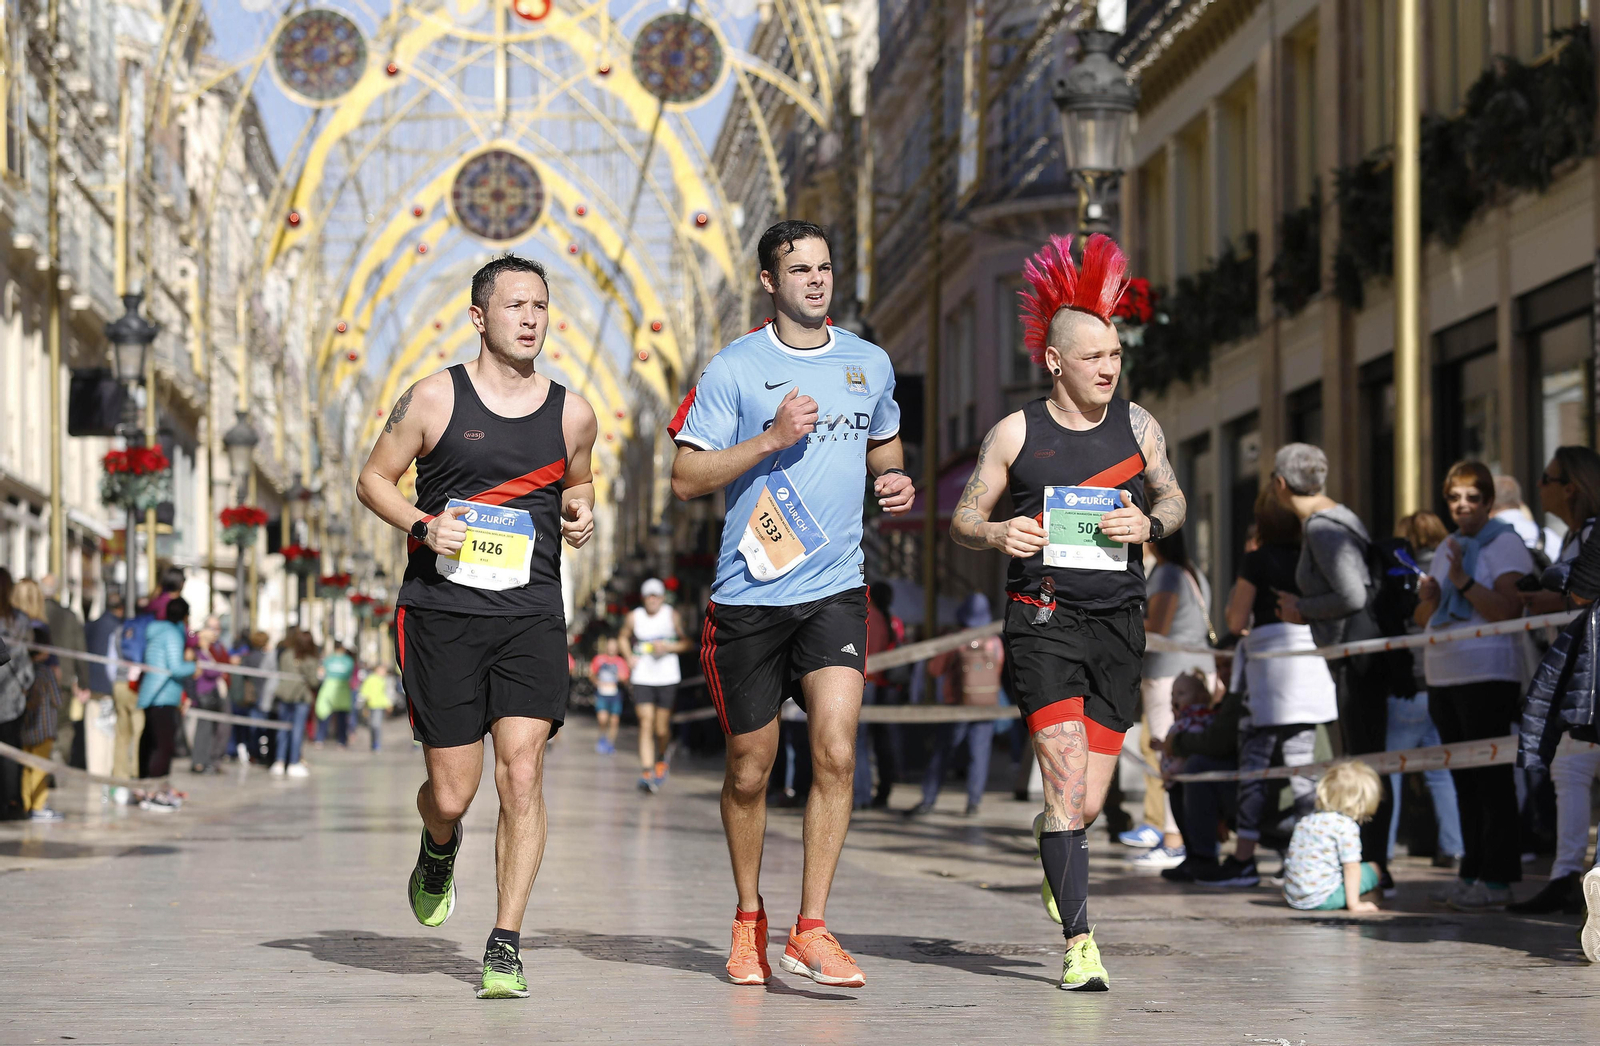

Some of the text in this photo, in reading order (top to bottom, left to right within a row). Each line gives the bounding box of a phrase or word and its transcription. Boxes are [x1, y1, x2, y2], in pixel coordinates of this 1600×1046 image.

[1080, 497, 1114, 506] ZURICH
[480, 514, 516, 527] ZURICH
[785, 501, 808, 532] ZURICH
[759, 511, 782, 543] 1533
[472, 540, 503, 555] 1426
